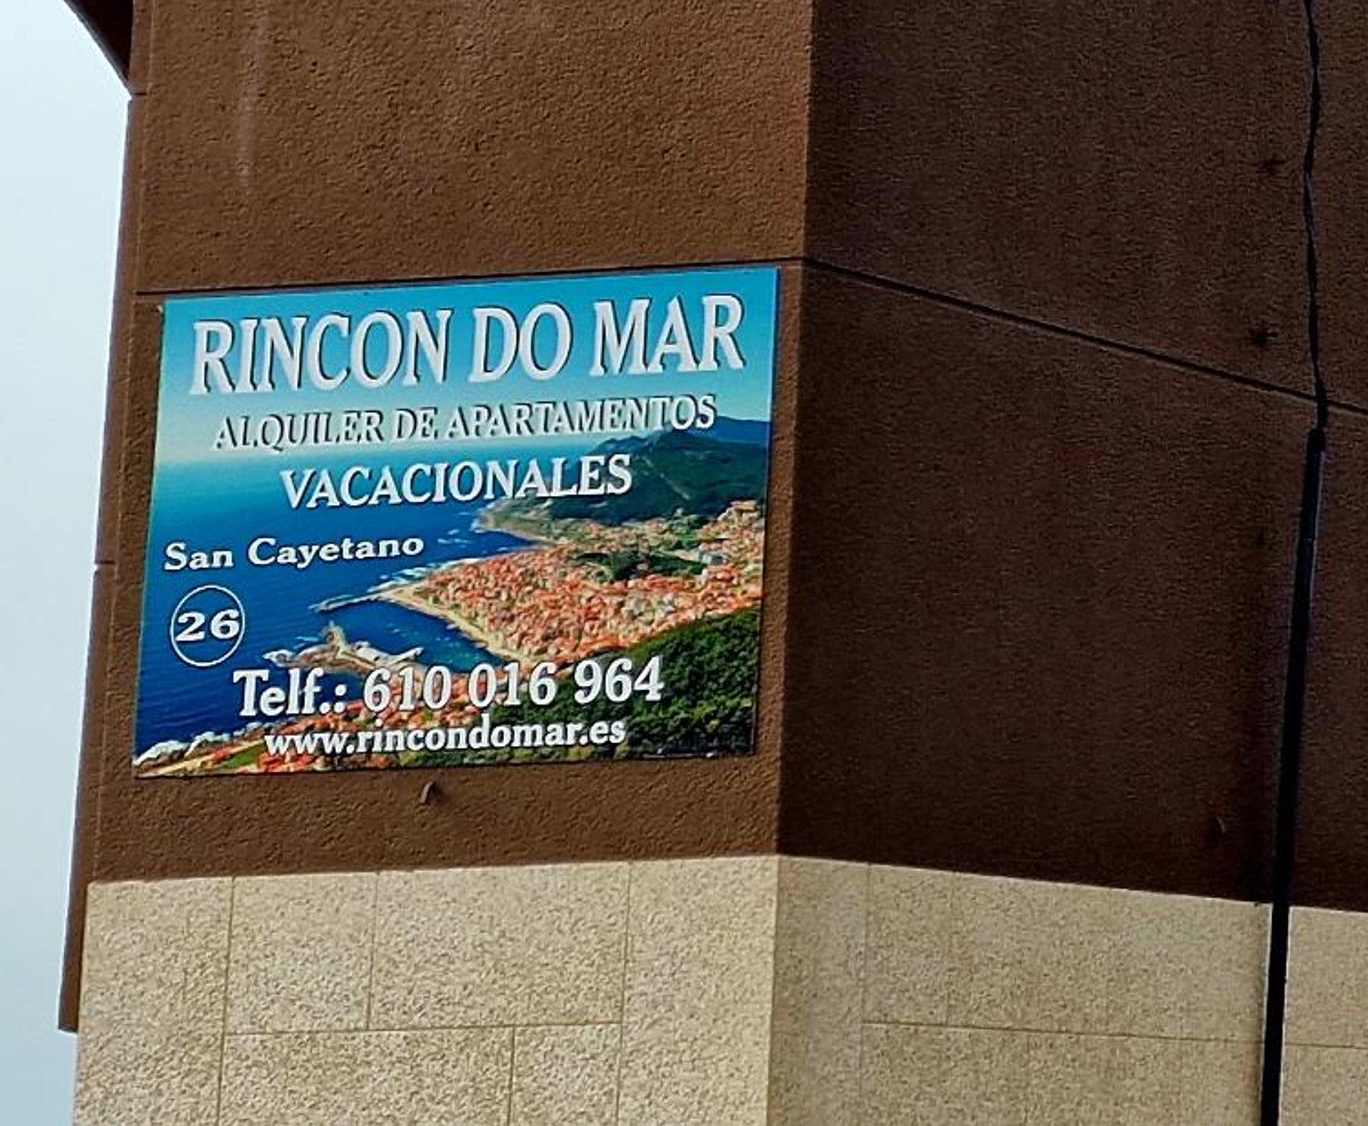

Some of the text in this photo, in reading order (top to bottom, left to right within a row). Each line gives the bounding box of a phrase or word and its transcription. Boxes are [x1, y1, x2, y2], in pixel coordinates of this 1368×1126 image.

[190, 293, 747, 395] RINCON DO MAR
[213, 393, 718, 452] ALQUILER DE APARTAMENTOS
[279, 453, 633, 510] VACACIONALES
[163, 534, 425, 572] San Cayetano
[175, 607, 240, 642] 26
[233, 655, 665, 717] Telf.: 610 016 964
[264, 714, 627, 756] www.rincondomar.es
